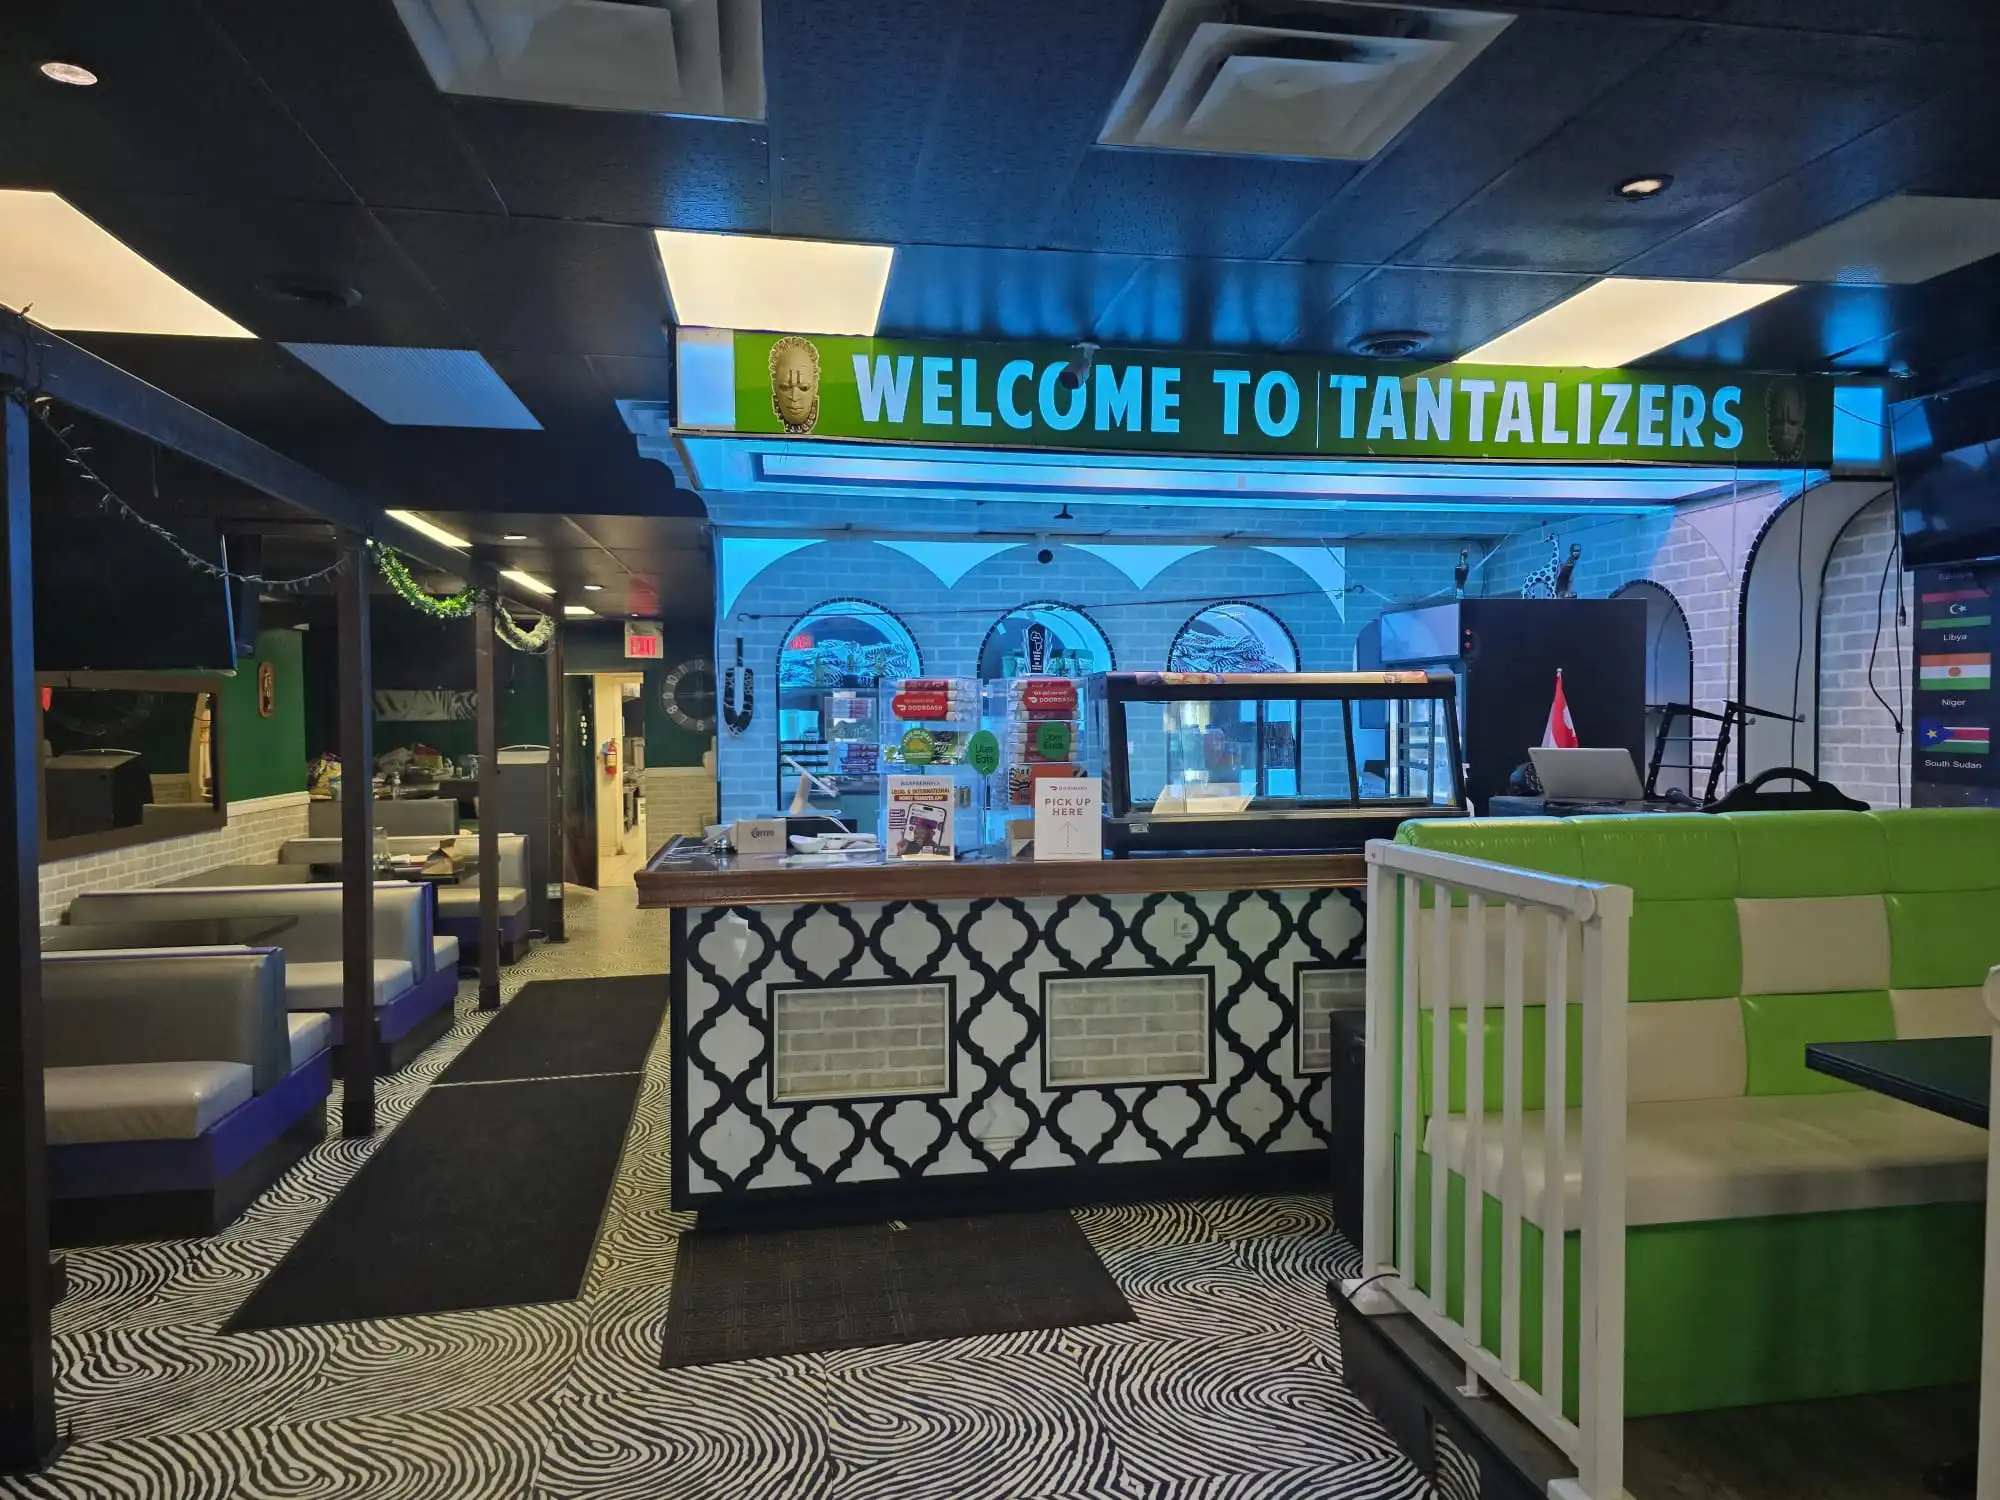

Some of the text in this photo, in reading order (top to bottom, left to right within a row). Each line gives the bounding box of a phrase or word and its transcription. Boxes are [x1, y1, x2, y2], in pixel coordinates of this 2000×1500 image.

[852, 353, 1743, 450] WELCOME TO TANTALIZERS
[1943, 634, 1968, 642] Libya
[665, 675, 678, 686] 10
[1941, 699, 1967, 708] Niger
[666, 704, 678, 714] 8
[1924, 760, 1982, 769] South Sudan
[1045, 798, 1091, 806] PICK UP
[1052, 808, 1084, 816] HERE
